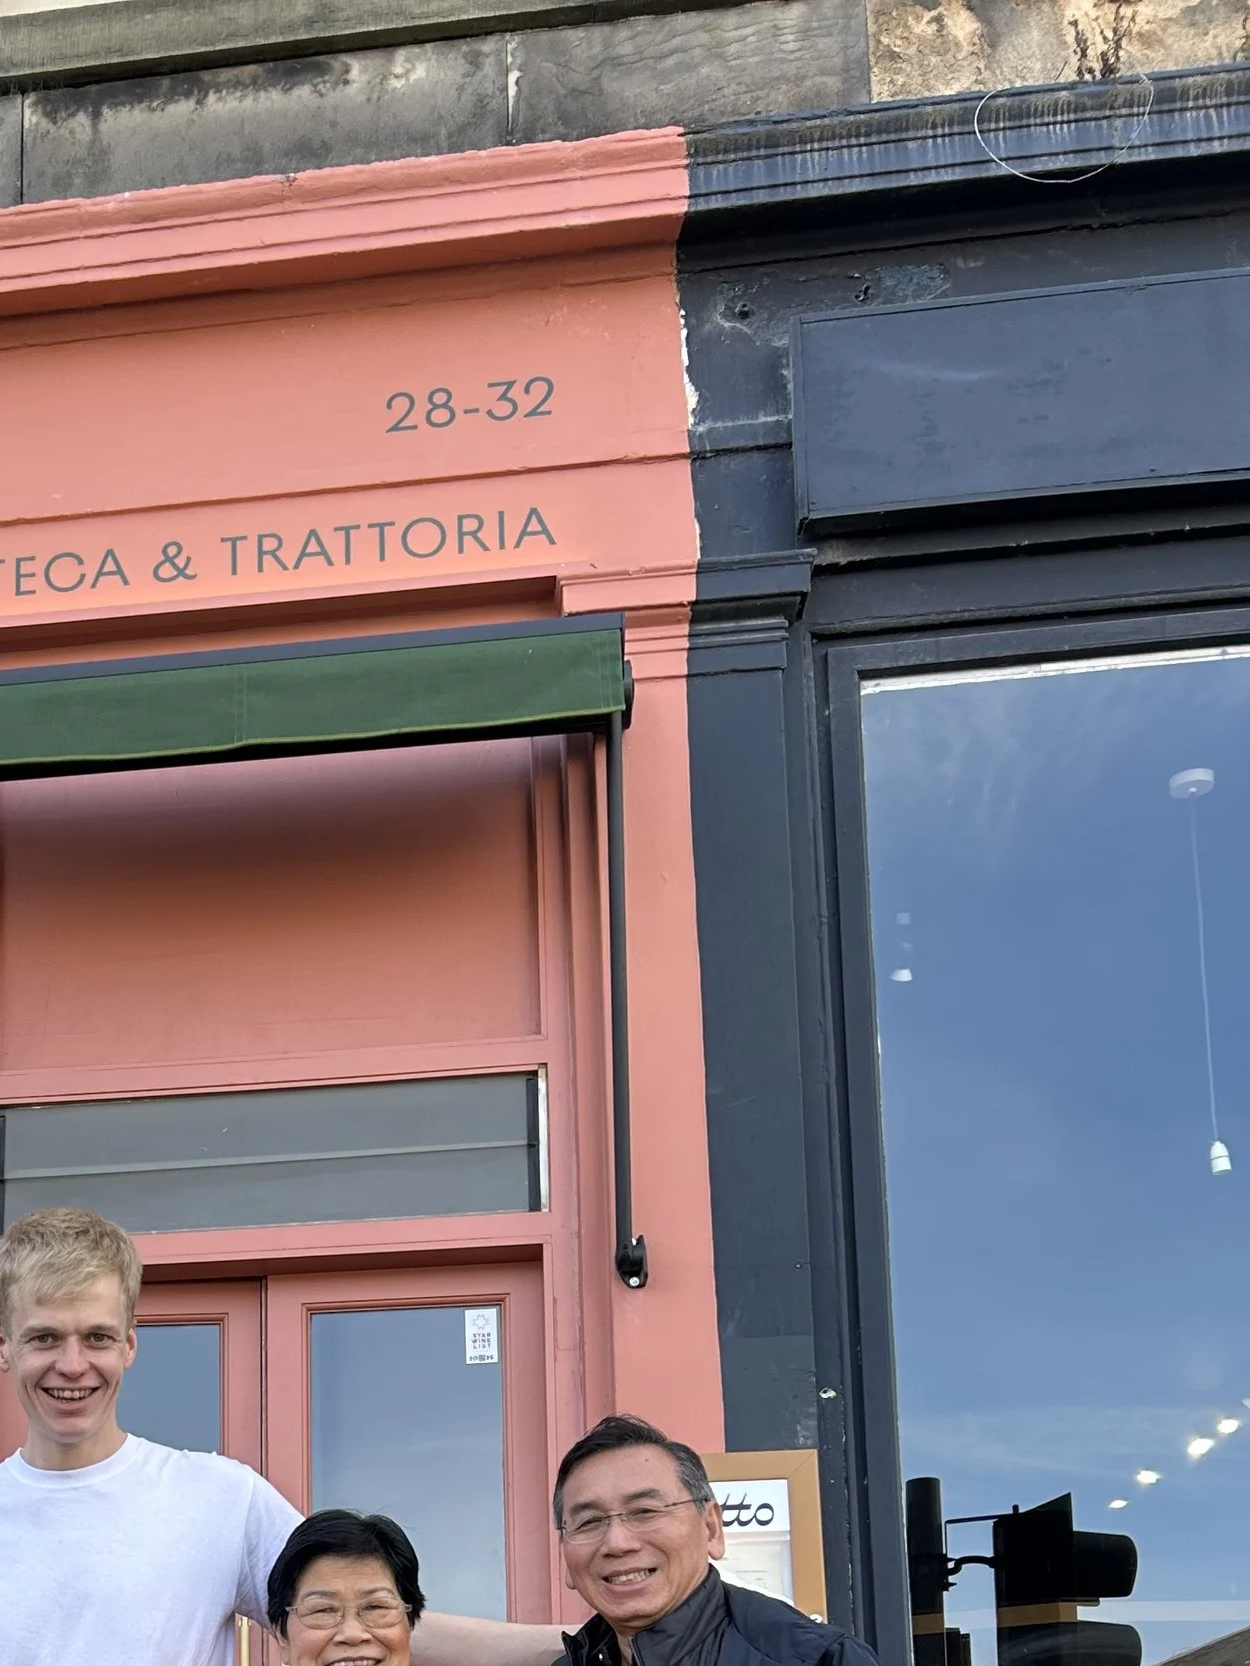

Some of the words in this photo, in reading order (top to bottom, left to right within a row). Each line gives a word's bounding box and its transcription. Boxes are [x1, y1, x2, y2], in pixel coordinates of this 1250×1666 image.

[384, 376, 557, 434] 28-32
[151, 540, 198, 583] &
[219, 506, 558, 577] TRATTORIA
[721, 1492, 775, 1527] tto
